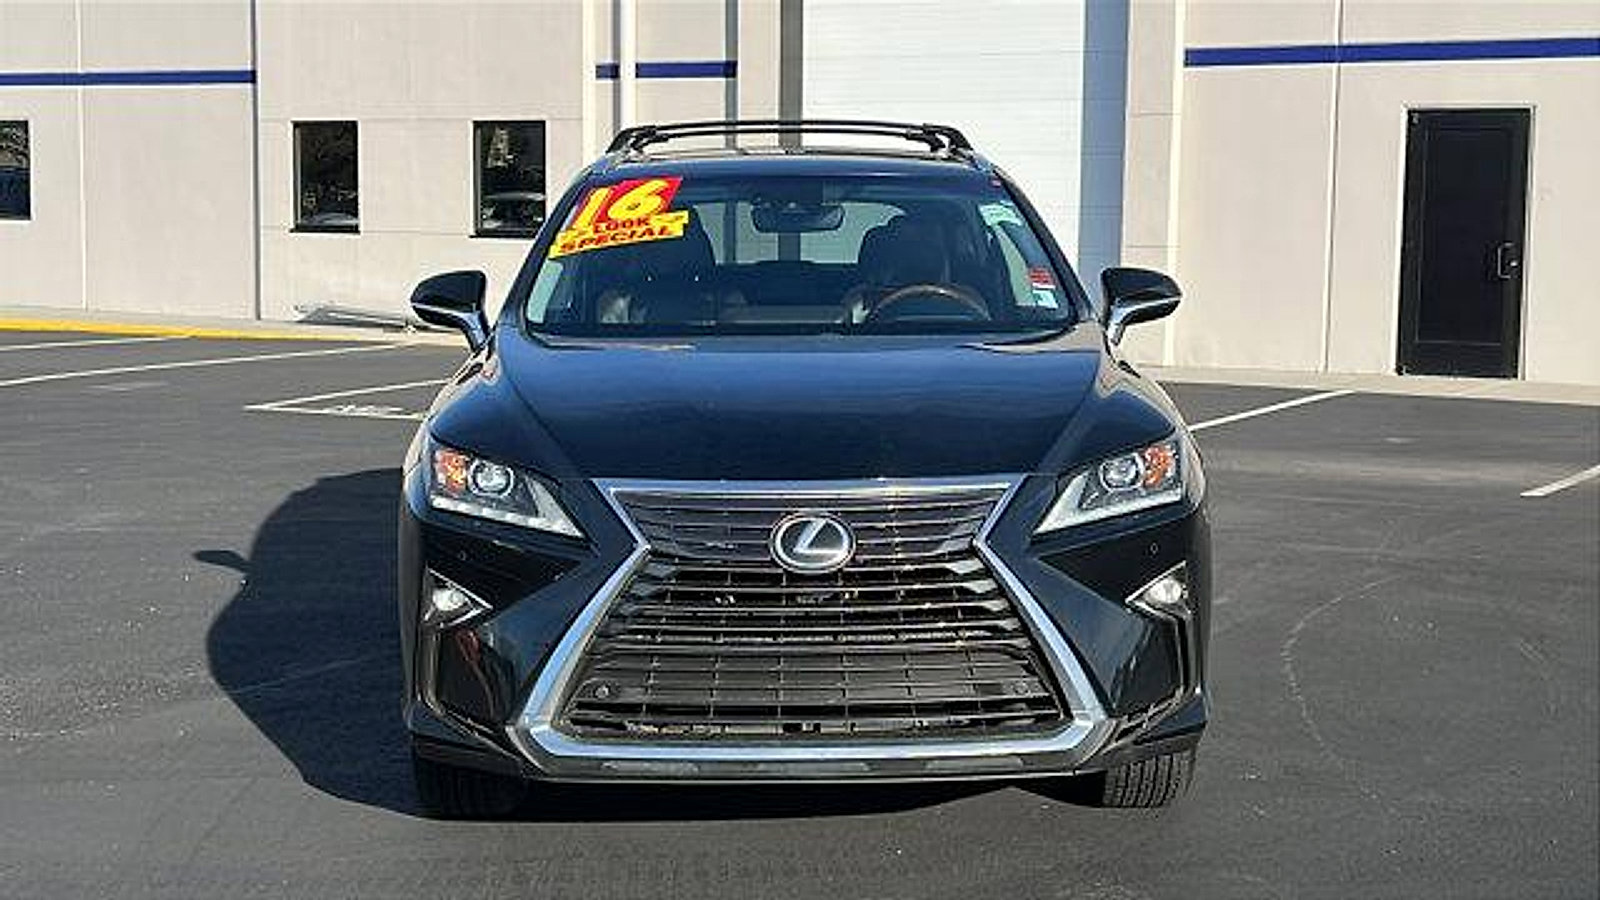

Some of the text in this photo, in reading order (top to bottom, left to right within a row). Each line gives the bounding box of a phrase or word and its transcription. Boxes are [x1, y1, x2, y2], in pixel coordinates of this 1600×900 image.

[572, 179, 668, 231] 16
[559, 225, 671, 253] SPECIAL
[593, 217, 650, 233] LOOK
